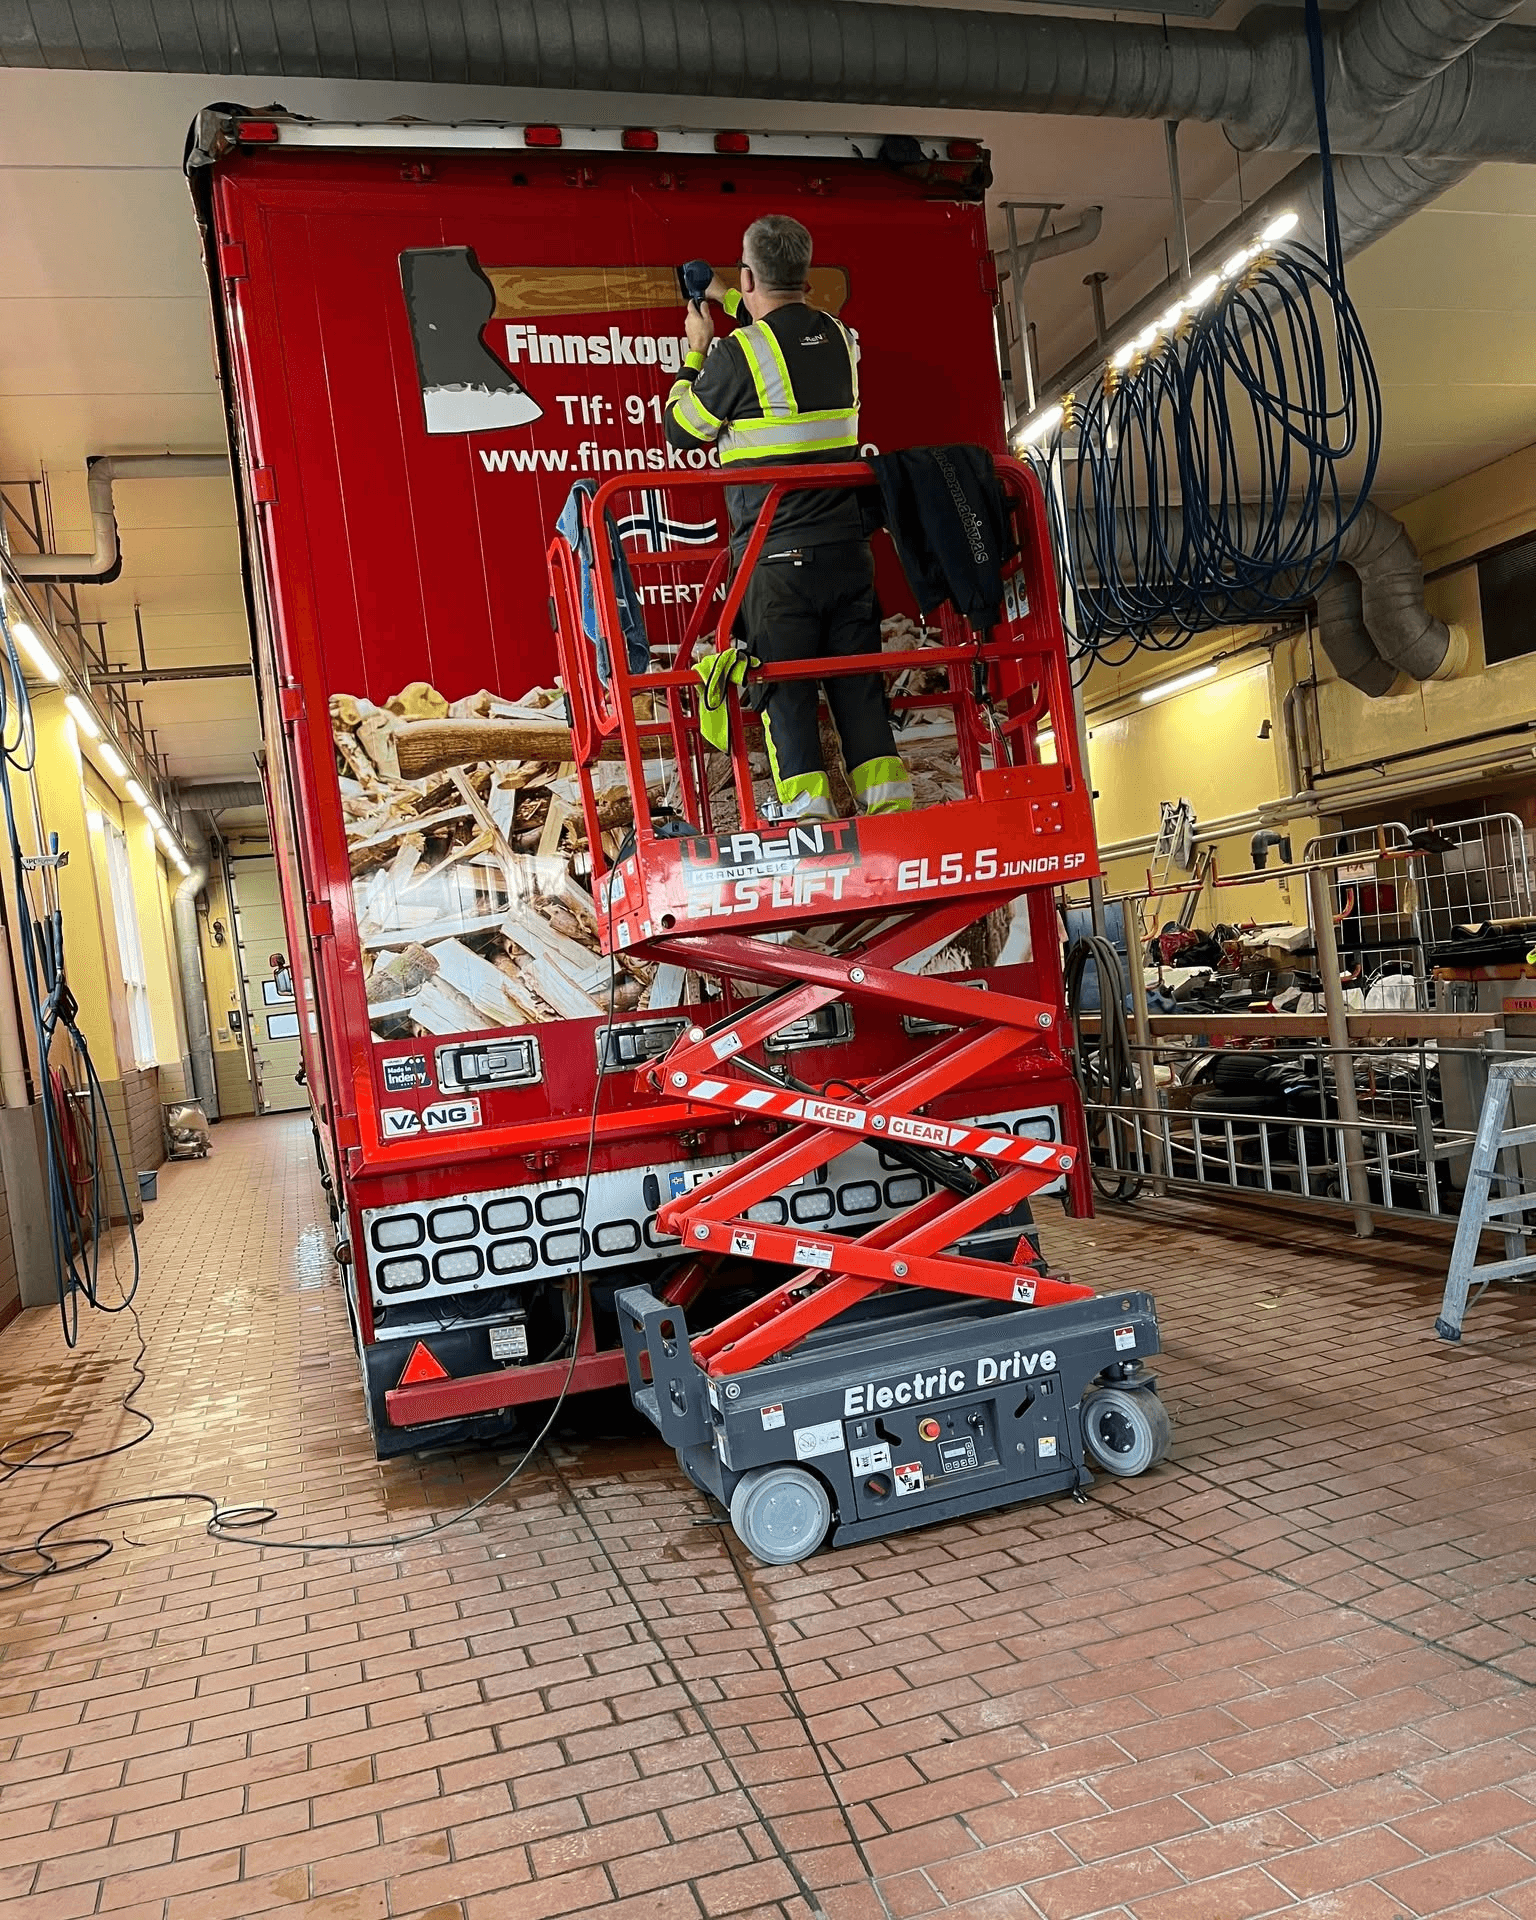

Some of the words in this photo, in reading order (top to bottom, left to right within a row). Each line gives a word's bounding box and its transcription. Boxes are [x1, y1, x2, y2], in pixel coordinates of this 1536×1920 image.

[505, 324, 722, 373] Finnskog
[556, 395, 614, 425] Tlf:
[771, 867, 851, 909] LIFT
[897, 848, 998, 892] EL5.5
[999, 855, 1059, 878] JUNIOR
[1063, 852, 1086, 870] SP
[389, 1107, 467, 1130] VANG
[813, 1104, 857, 1123] KEEP
[892, 1120, 943, 1142] CLEAR
[844, 1367, 965, 1417] Electric
[977, 1349, 1057, 1387] Drive
